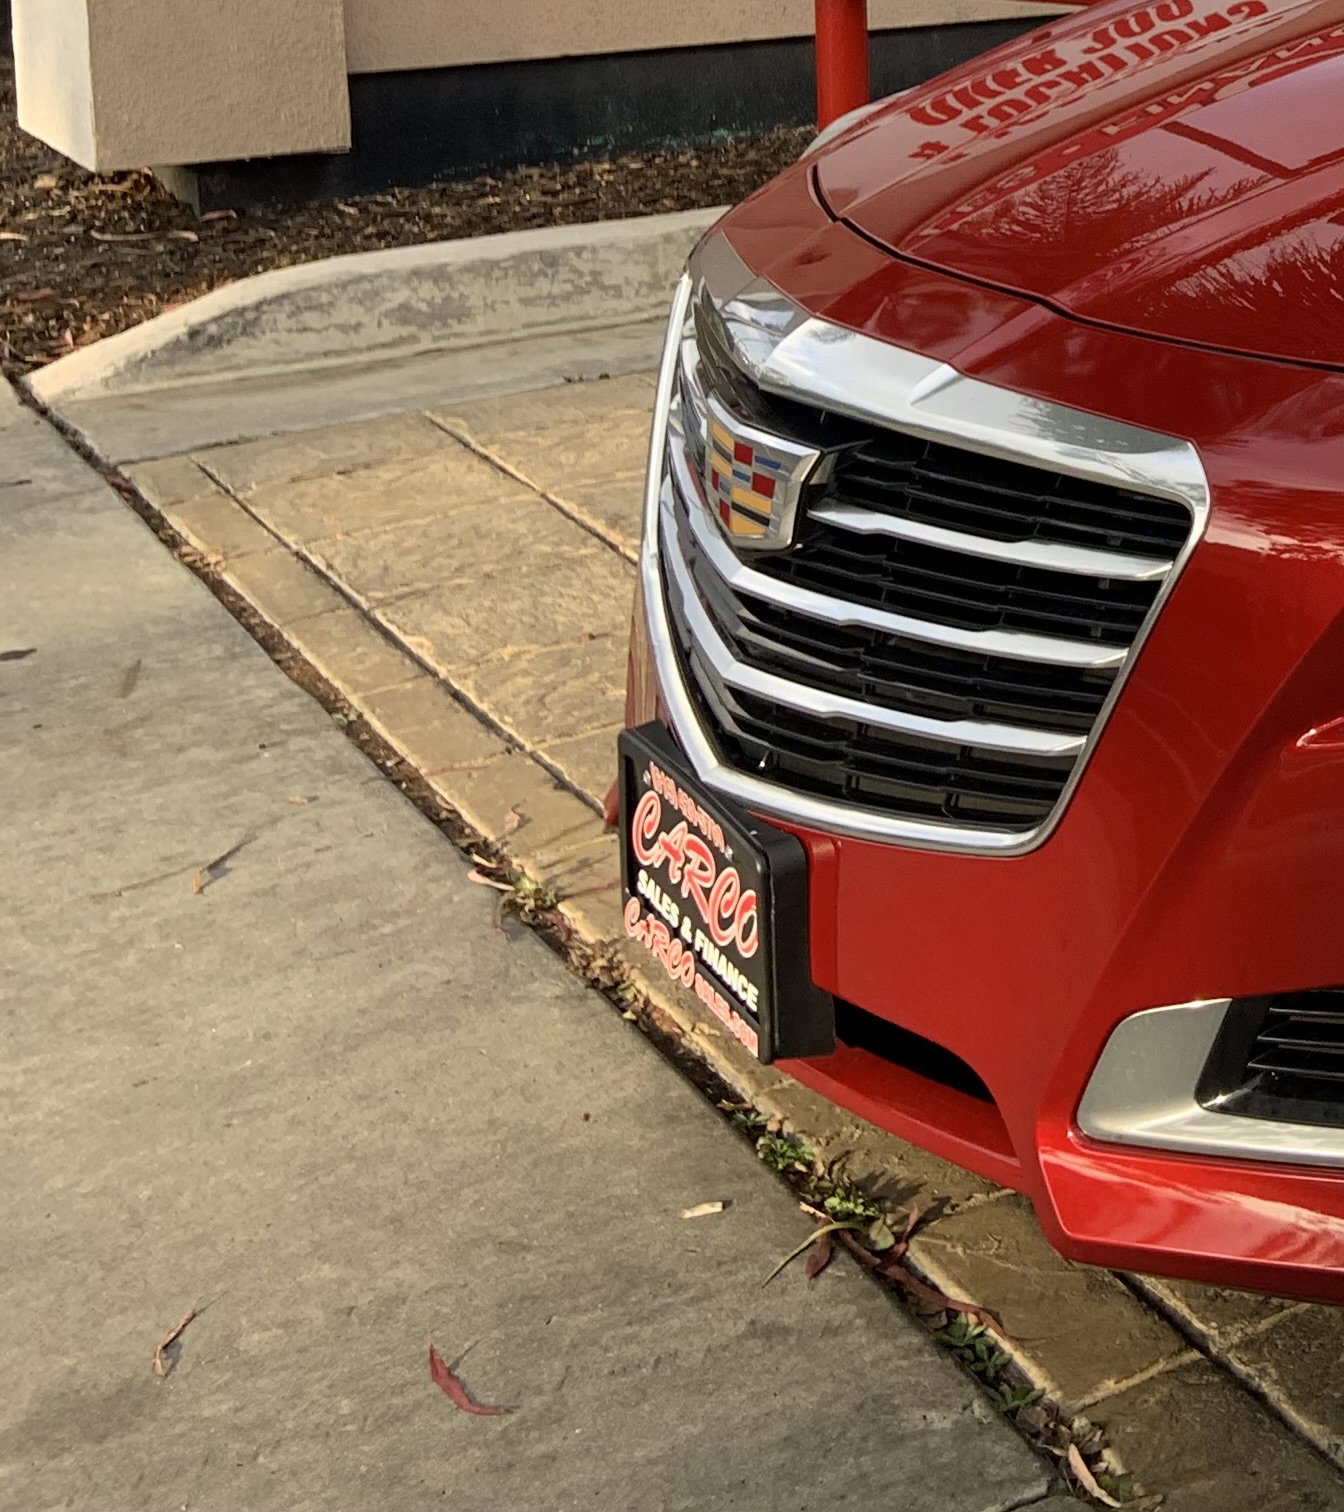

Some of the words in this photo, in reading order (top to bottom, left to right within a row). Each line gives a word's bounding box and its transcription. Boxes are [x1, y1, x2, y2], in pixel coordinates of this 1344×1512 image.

[631, 790, 759, 958] CARCO
[637, 869, 680, 929] SALES
[680, 915, 693, 944] &
[694, 928, 760, 1013] FINANCE
